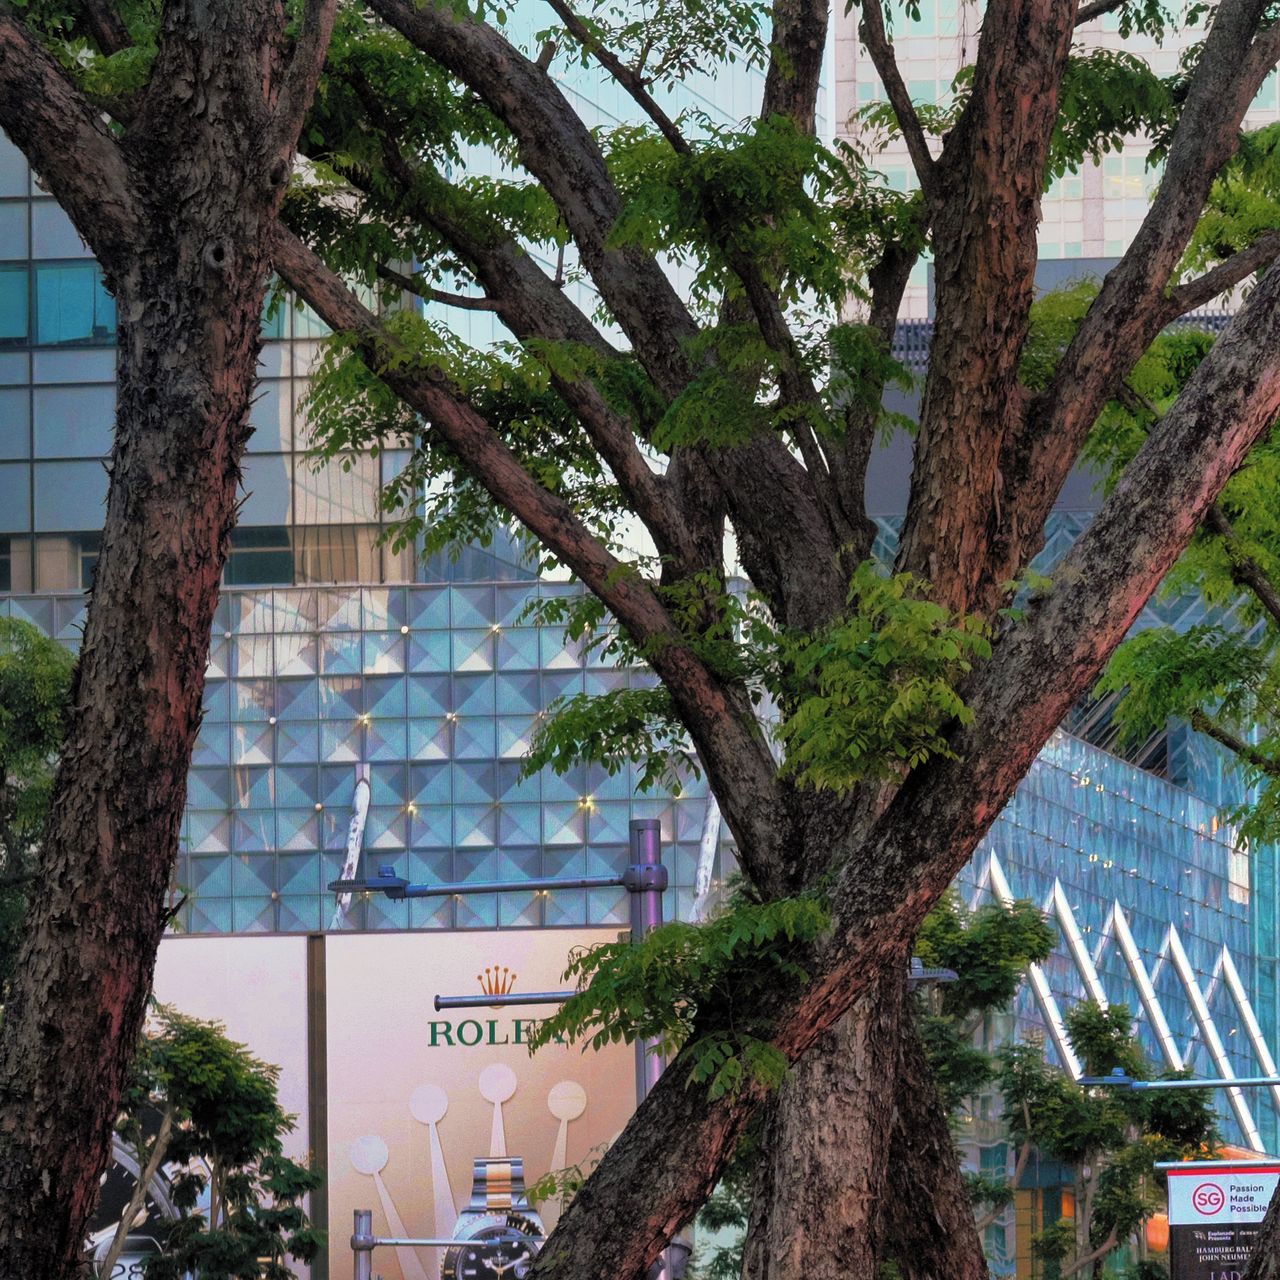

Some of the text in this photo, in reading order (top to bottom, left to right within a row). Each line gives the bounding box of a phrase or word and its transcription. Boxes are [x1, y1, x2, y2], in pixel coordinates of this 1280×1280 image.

[428, 1018, 566, 1047] ROLE
[1198, 1193, 1220, 1206] SG
[1199, 1254, 1220, 1262] JOHN
